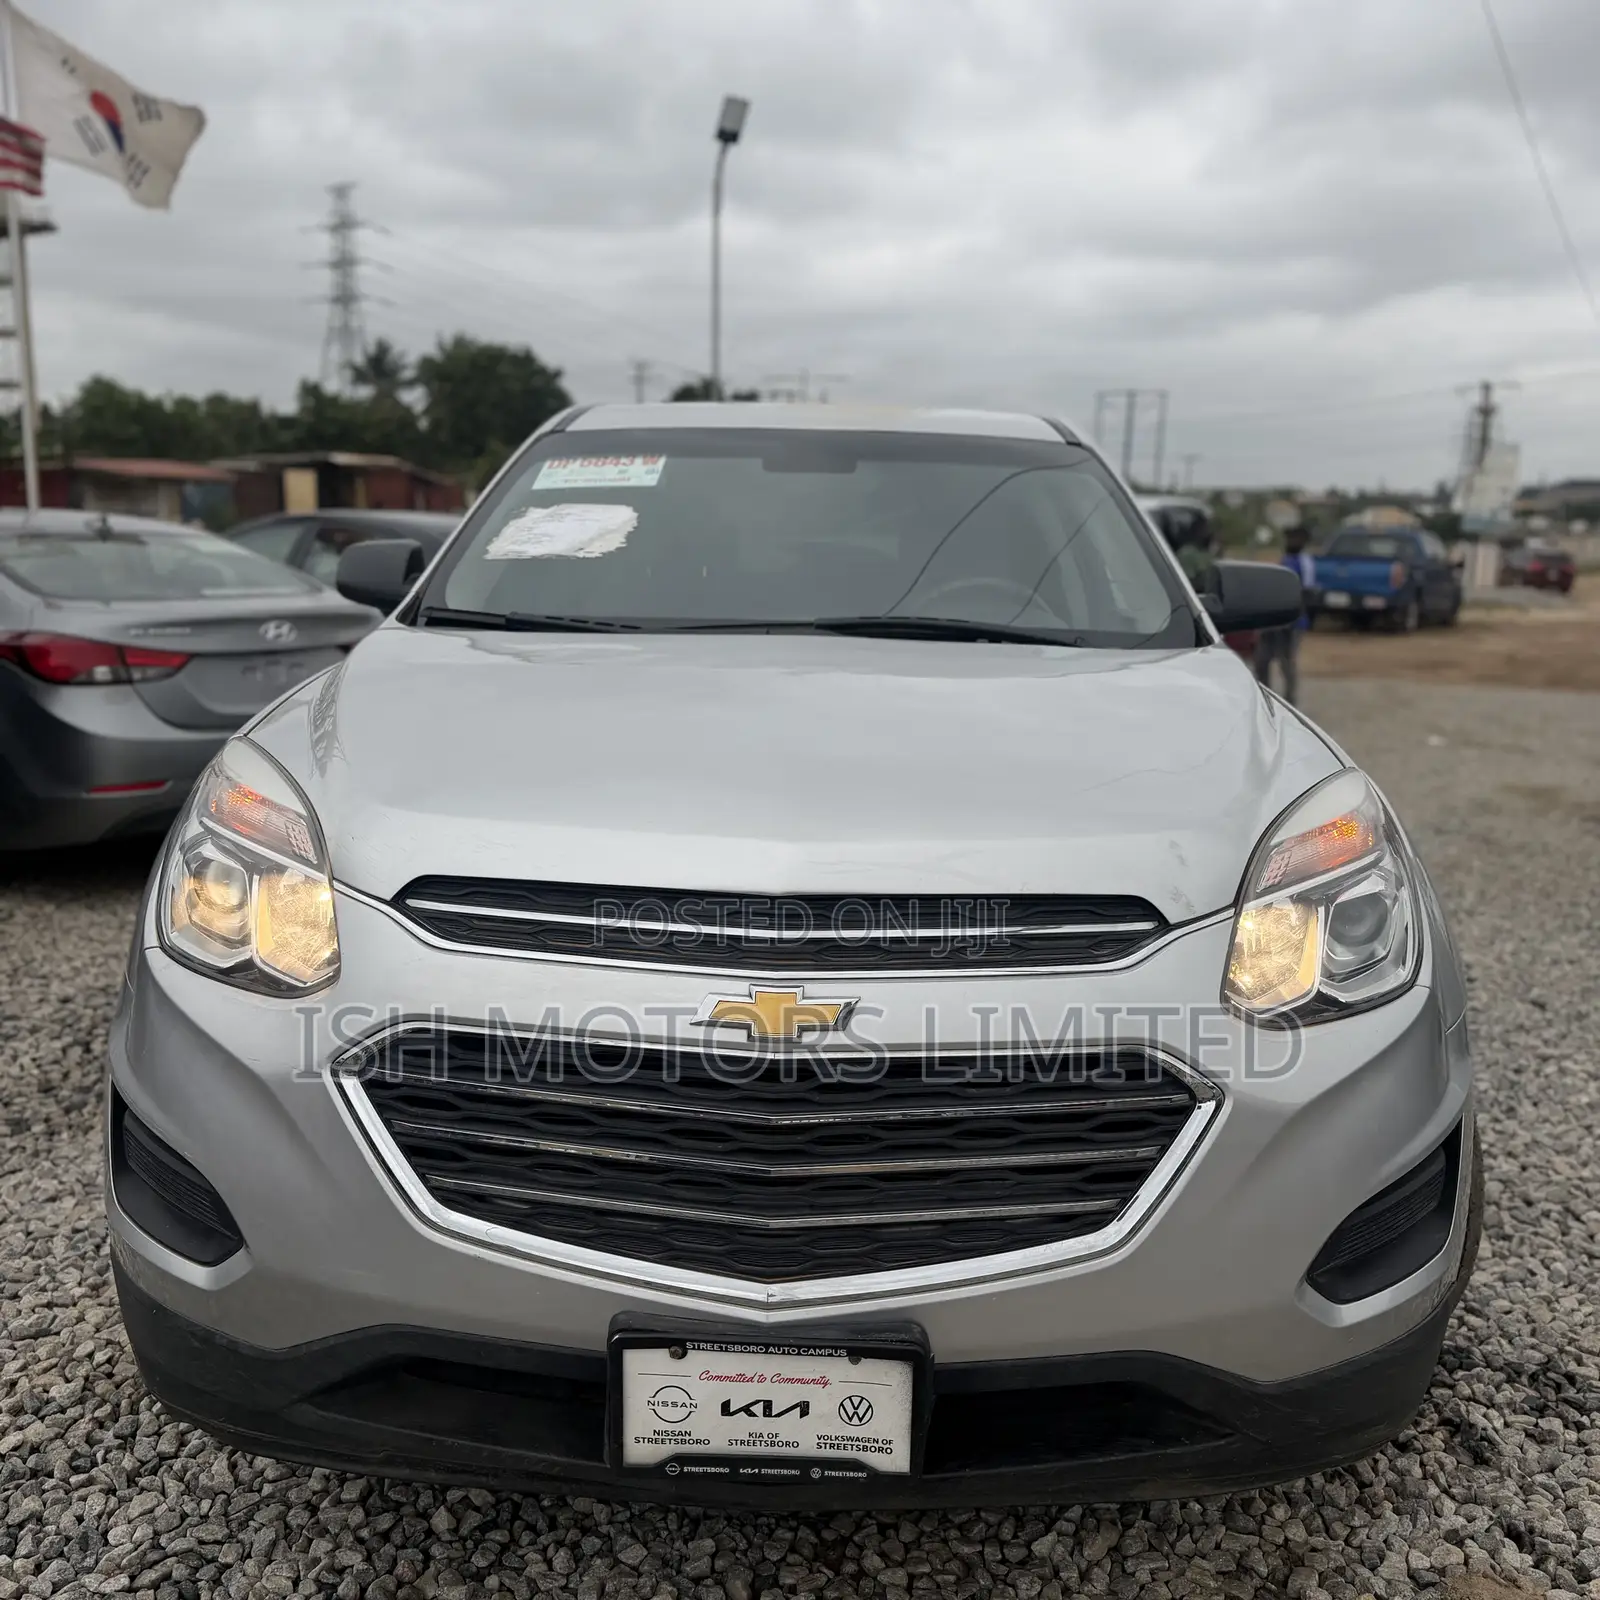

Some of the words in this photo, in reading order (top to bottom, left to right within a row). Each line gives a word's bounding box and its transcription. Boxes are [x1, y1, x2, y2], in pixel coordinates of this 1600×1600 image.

[686, 1341, 765, 1353] STREETSBORO
[768, 1346, 798, 1355] AUTO
[800, 1347, 847, 1357] CAMPUS
[698, 1370, 757, 1383] Committed
[756, 1373, 767, 1384] to
[647, 1400, 698, 1409] NISSAN
[653, 1429, 692, 1437] NISSAN
[748, 1431, 764, 1440] KIA
[766, 1432, 780, 1440] OF
[634, 1436, 711, 1446] STREETSBORO
[727, 1439, 800, 1449] STREETSBORO
[816, 1434, 879, 1445] VOLKSWAGEN
[881, 1438, 894, 1446] OF
[816, 1441, 893, 1455] STREETSBORO
[683, 1466, 730, 1474] STREETSBORO
[760, 1468, 800, 1476] STREETSBORO
[824, 1470, 868, 1478] STREETSBORO
